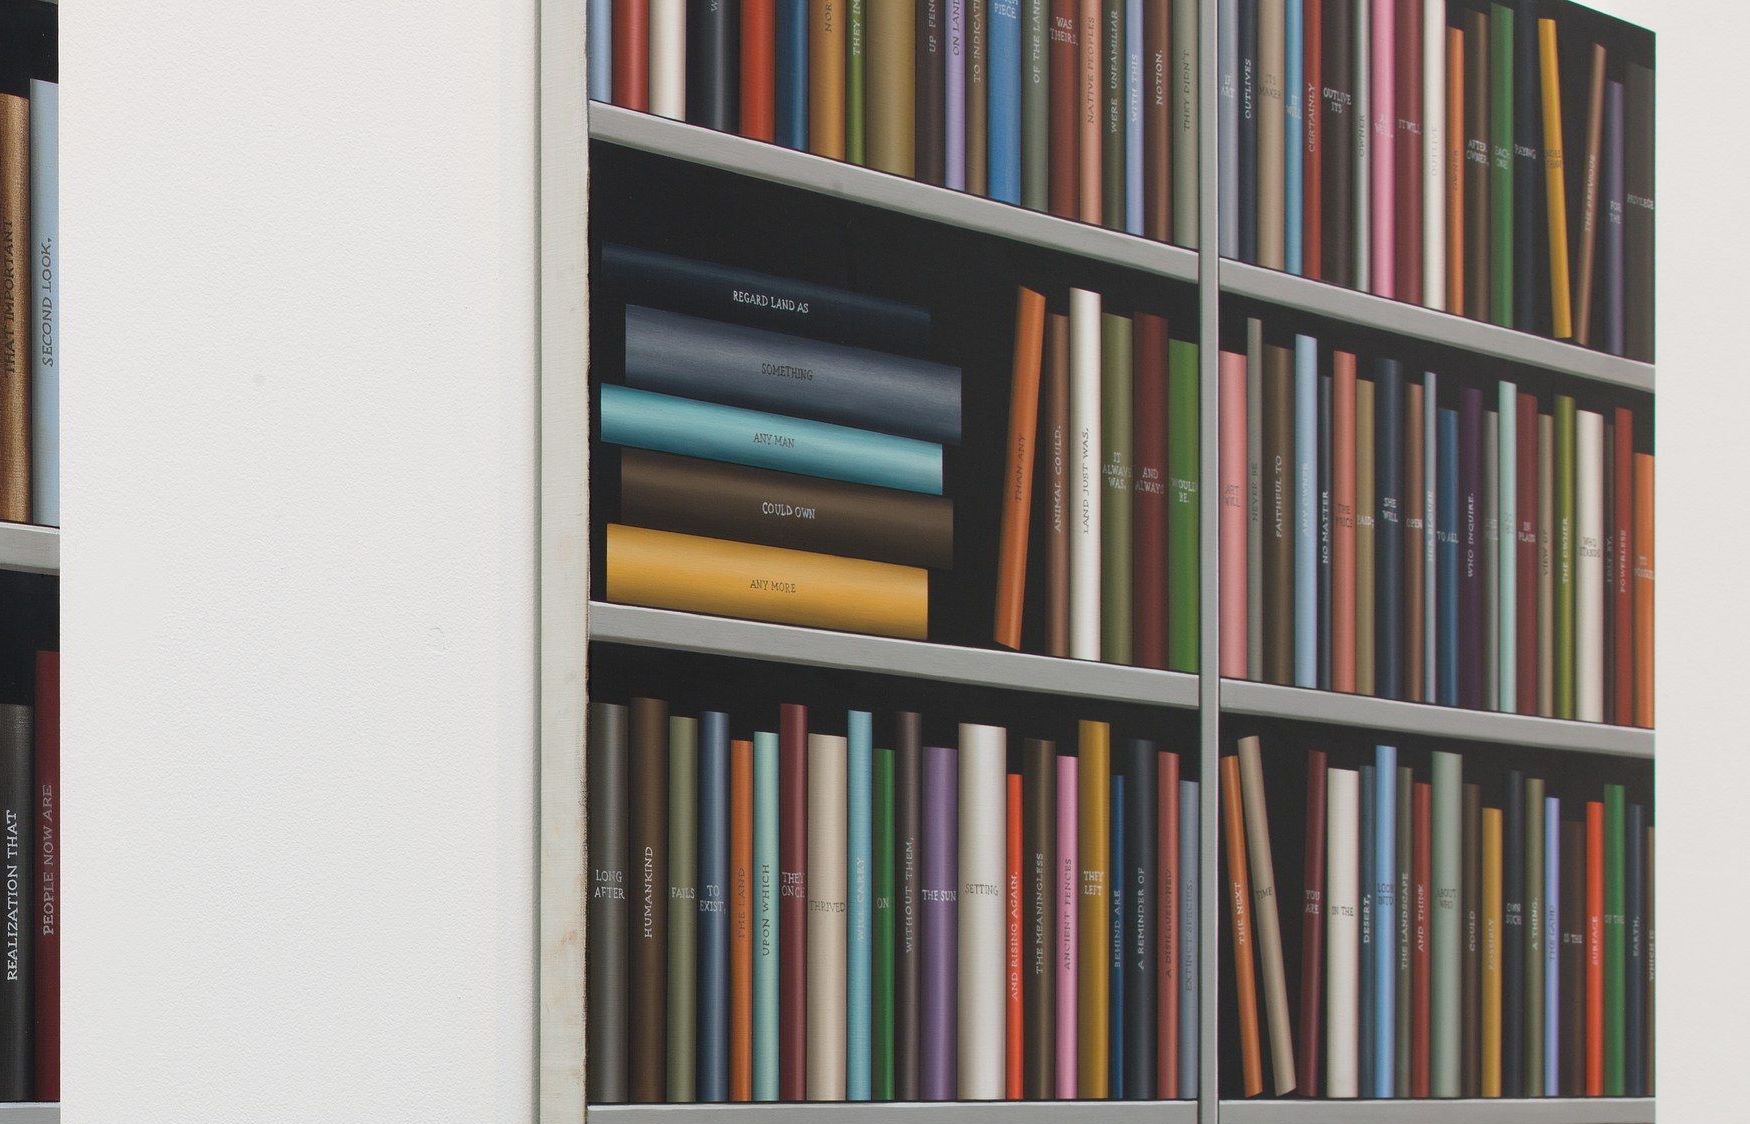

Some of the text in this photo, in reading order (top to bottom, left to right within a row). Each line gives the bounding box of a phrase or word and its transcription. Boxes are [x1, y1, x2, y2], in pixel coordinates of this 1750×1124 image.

[41, 238, 54, 367] SECOND LOOK,
[733, 290, 809, 314] REGARD LAND AS
[761, 363, 813, 381] SOMETHING
[753, 433, 794, 448] ANY MAN
[1142, 467, 1158, 479] AND
[1135, 482, 1164, 495] ALWAYS
[762, 502, 815, 520] COULD OWN
[1054, 480, 1062, 533] ANIMAL
[750, 579, 796, 593] ANY MORE
[596, 869, 622, 882] LONG
[1084, 870, 1103, 882] THEY
[6, 810, 18, 981] REALIZATION THAT
[594, 887, 625, 899] AFTER
[644, 846, 652, 938] HUMANKIND
[707, 885, 720, 897] TO
[922, 889, 956, 901] THE SUN
[965, 884, 999, 895] SETTING
[1084, 885, 1102, 896] LEFT
[700, 901, 726, 914] EXIST,
[762, 864, 770, 955] UPON WHICH
